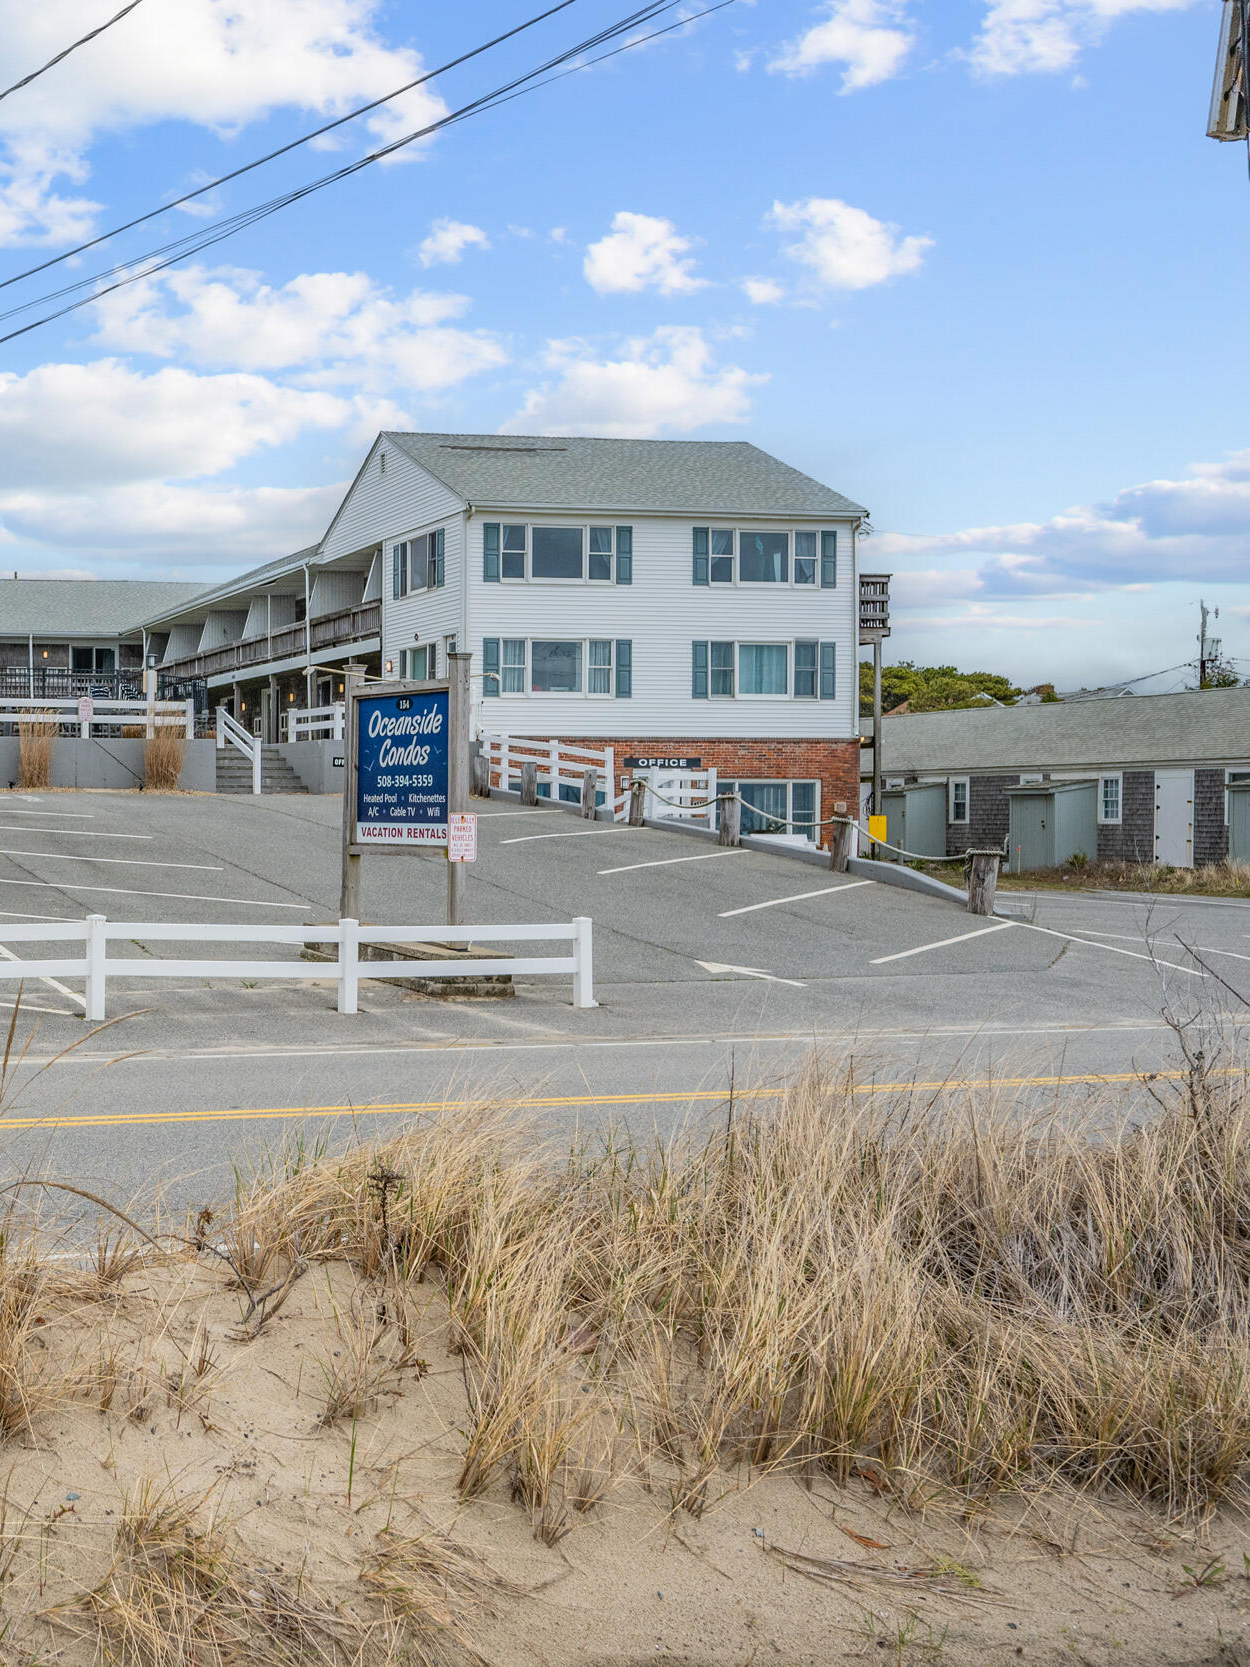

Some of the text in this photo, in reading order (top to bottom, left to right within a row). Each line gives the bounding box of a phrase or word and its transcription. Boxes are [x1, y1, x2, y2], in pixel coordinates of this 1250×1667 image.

[399, 699, 410, 709] 154
[368, 704, 443, 739] Oceanside
[379, 736, 430, 768] Condos
[638, 758, 687, 767] OFFICE
[377, 774, 433, 788] 508-394-5359
[363, 793, 446, 803] Heated Pool Kitchenettes
[368, 806, 441, 818] A/C Cable TV Wifi
[361, 826, 447, 839] VACATION RENTALS
